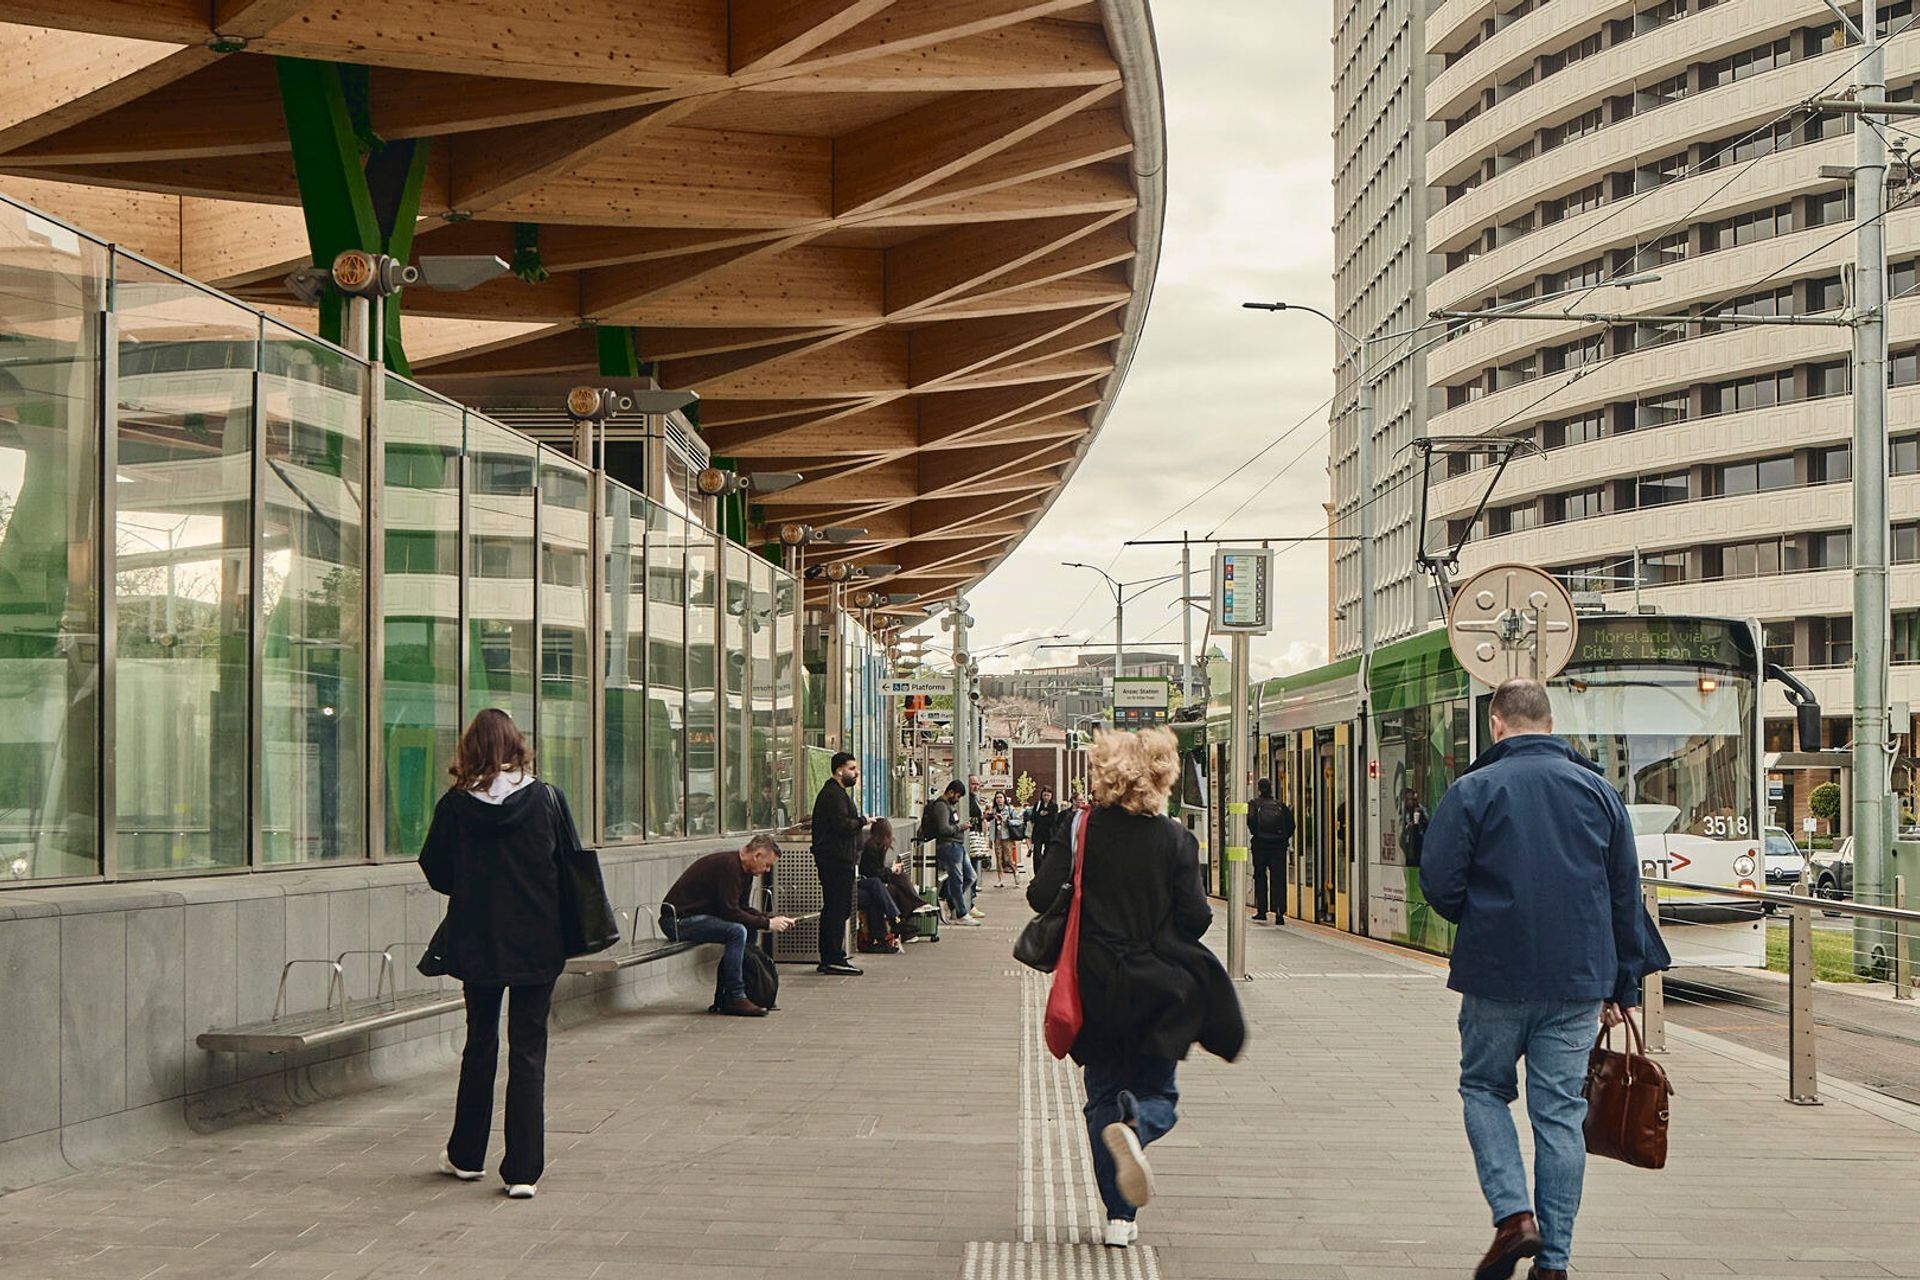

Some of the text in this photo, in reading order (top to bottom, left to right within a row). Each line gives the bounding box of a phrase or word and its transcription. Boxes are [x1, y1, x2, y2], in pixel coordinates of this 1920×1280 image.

[1595, 629, 1703, 643] Moreland via
[1582, 644, 1717, 659] City & Lygon St
[911, 683, 946, 691] Platforms
[1703, 815, 1748, 835] 3518
